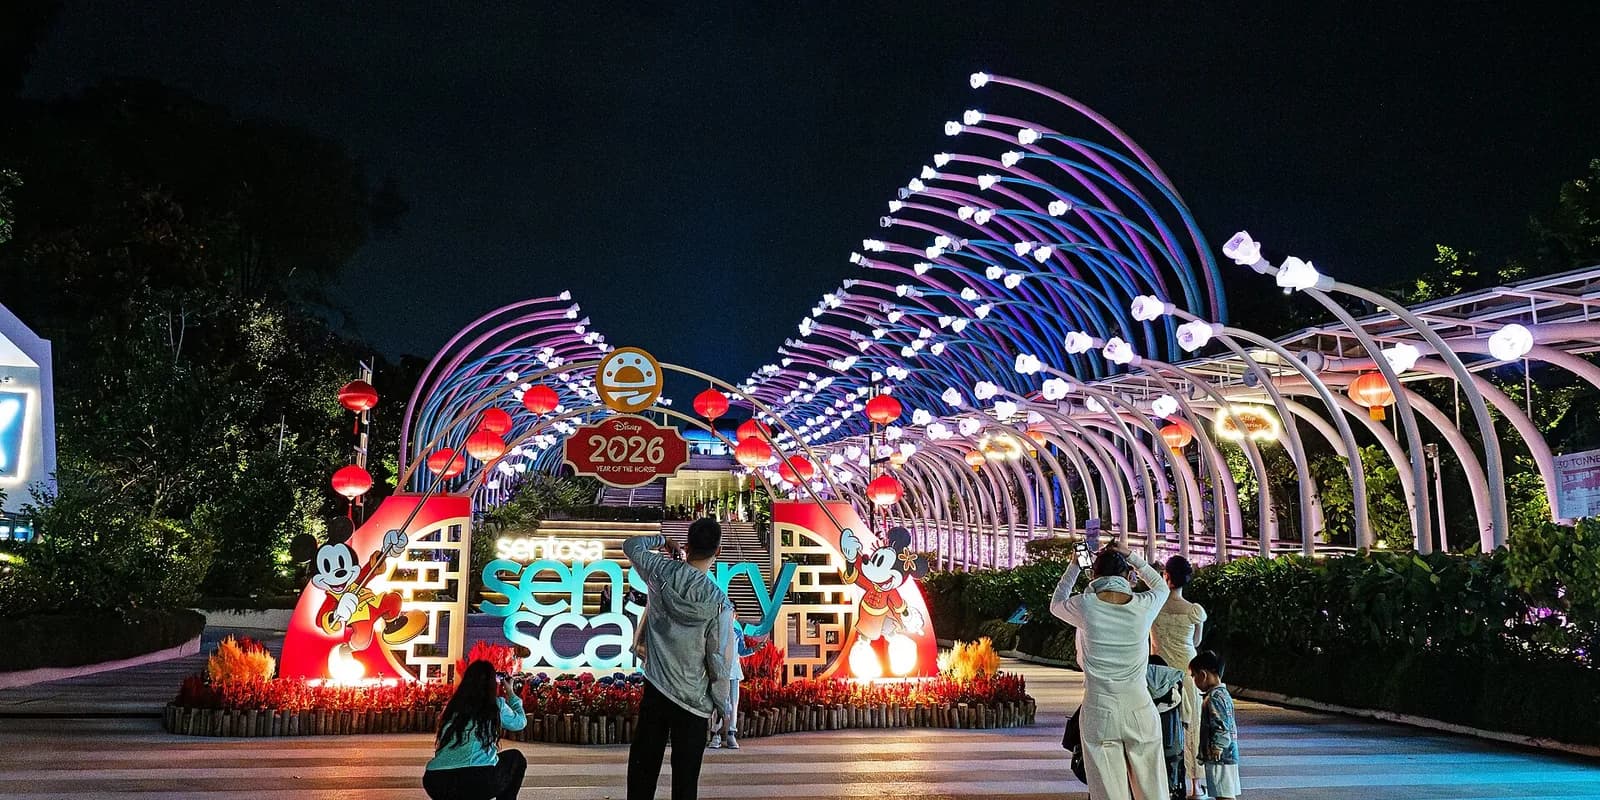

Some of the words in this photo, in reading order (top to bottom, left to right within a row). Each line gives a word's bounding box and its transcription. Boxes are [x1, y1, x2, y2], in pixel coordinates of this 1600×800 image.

[613, 420, 642, 433] Disney
[588, 435, 665, 464] 2026
[622, 465, 633, 473] THE
[496, 537, 604, 560] sentosa
[480, 559, 797, 637] senry
[502, 612, 647, 672] sca
